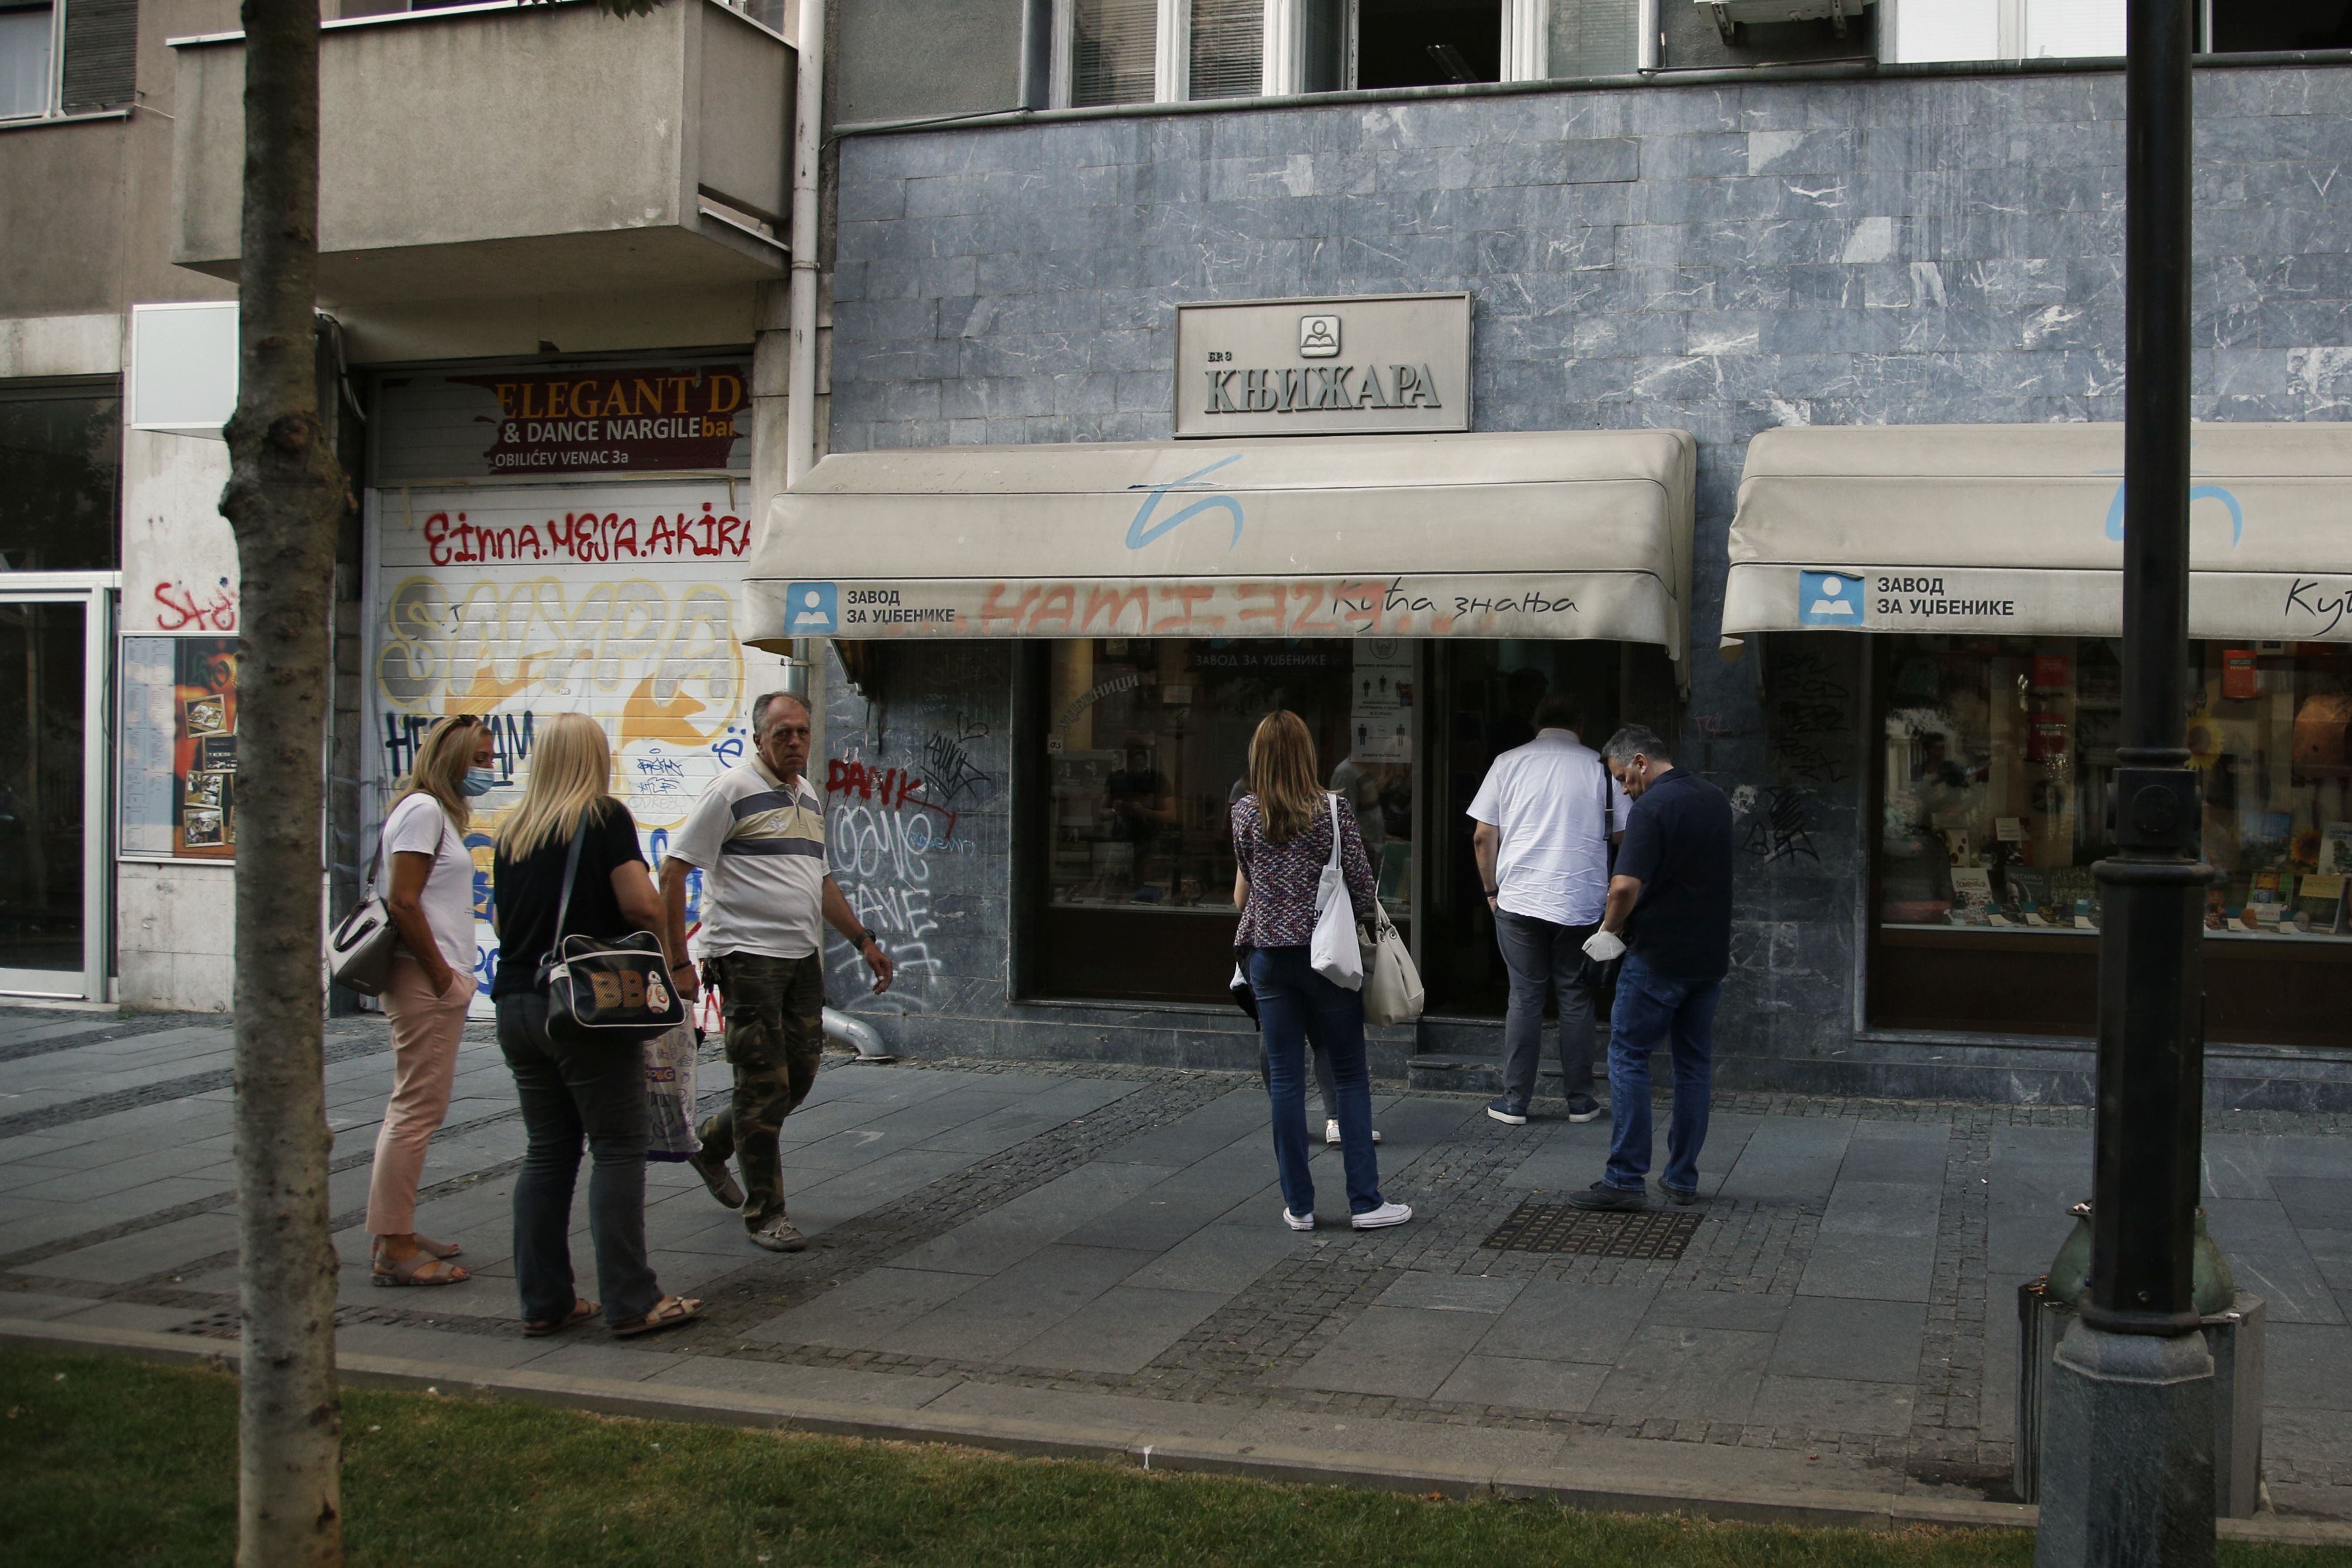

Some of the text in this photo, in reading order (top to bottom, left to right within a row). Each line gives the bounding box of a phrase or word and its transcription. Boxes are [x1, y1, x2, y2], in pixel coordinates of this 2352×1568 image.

[1225, 351, 1232, 362] 3
[1204, 363, 1442, 413] КЊИЖАРА
[495, 376, 697, 419] ELEGANT
[503, 422, 520, 443] &
[527, 420, 599, 443] DANCE
[495, 449, 629, 467] OBILIĆEV VENAC 3a
[1877, 577, 1945, 596] ЗАВОД
[847, 590, 901, 606] ЗАВОД
[847, 609, 956, 625] ЗА УЏБЕНИКЕ
[1876, 599, 2014, 617] ЗА УЏБЕНИКЕ
[1195, 653, 1327, 667] ЗАВОД ЗА УЏБЕНИКЕ
